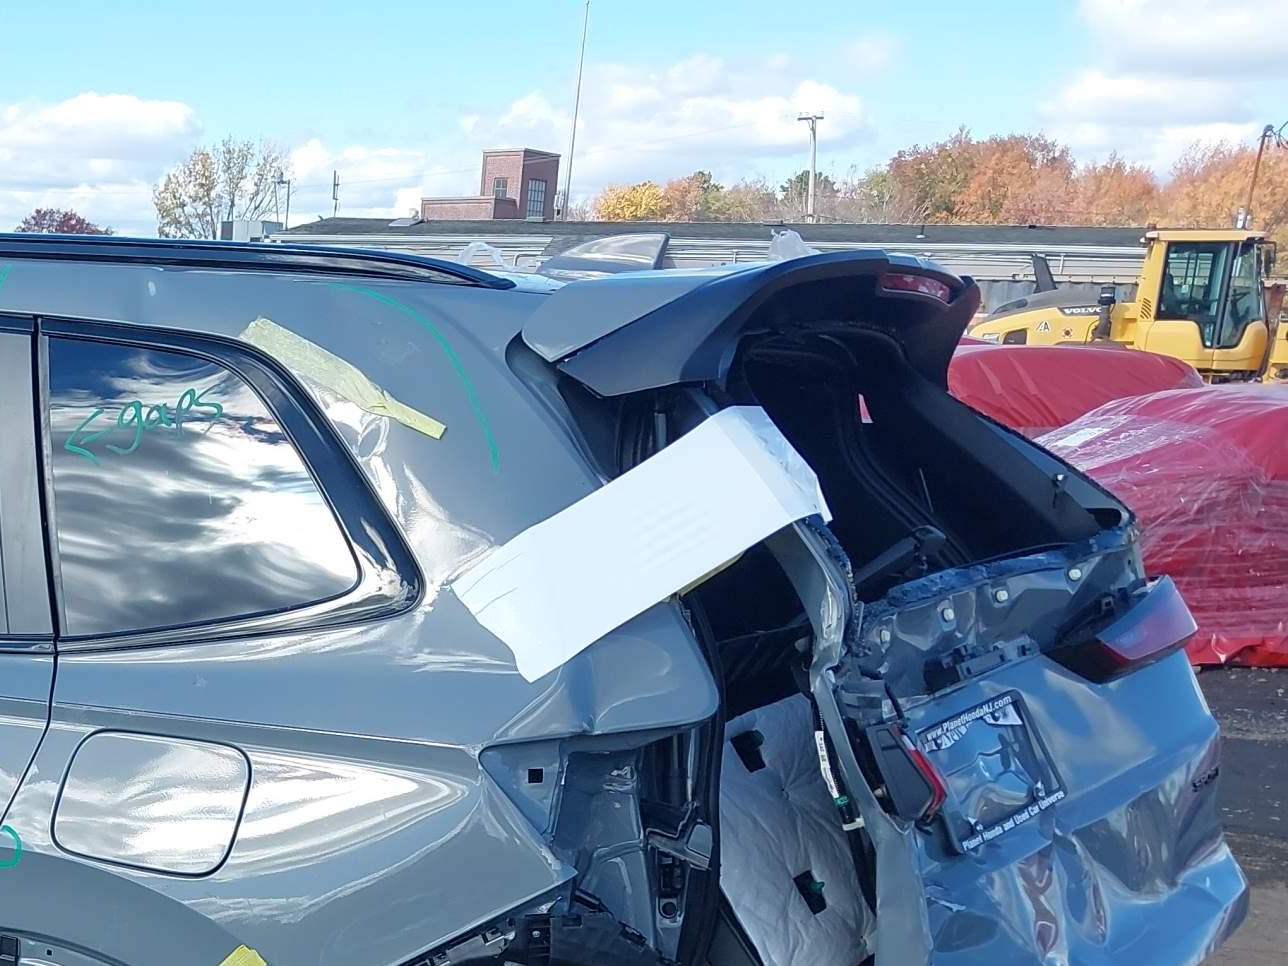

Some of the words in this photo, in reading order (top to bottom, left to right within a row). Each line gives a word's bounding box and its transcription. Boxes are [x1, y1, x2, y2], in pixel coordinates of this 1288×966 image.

[926, 695, 1012, 741] www.PlanetHondaNJ.com
[1014, 808, 1030, 826] Used
[1028, 802, 1041, 816] Car
[1038, 789, 1065, 811] Universe
